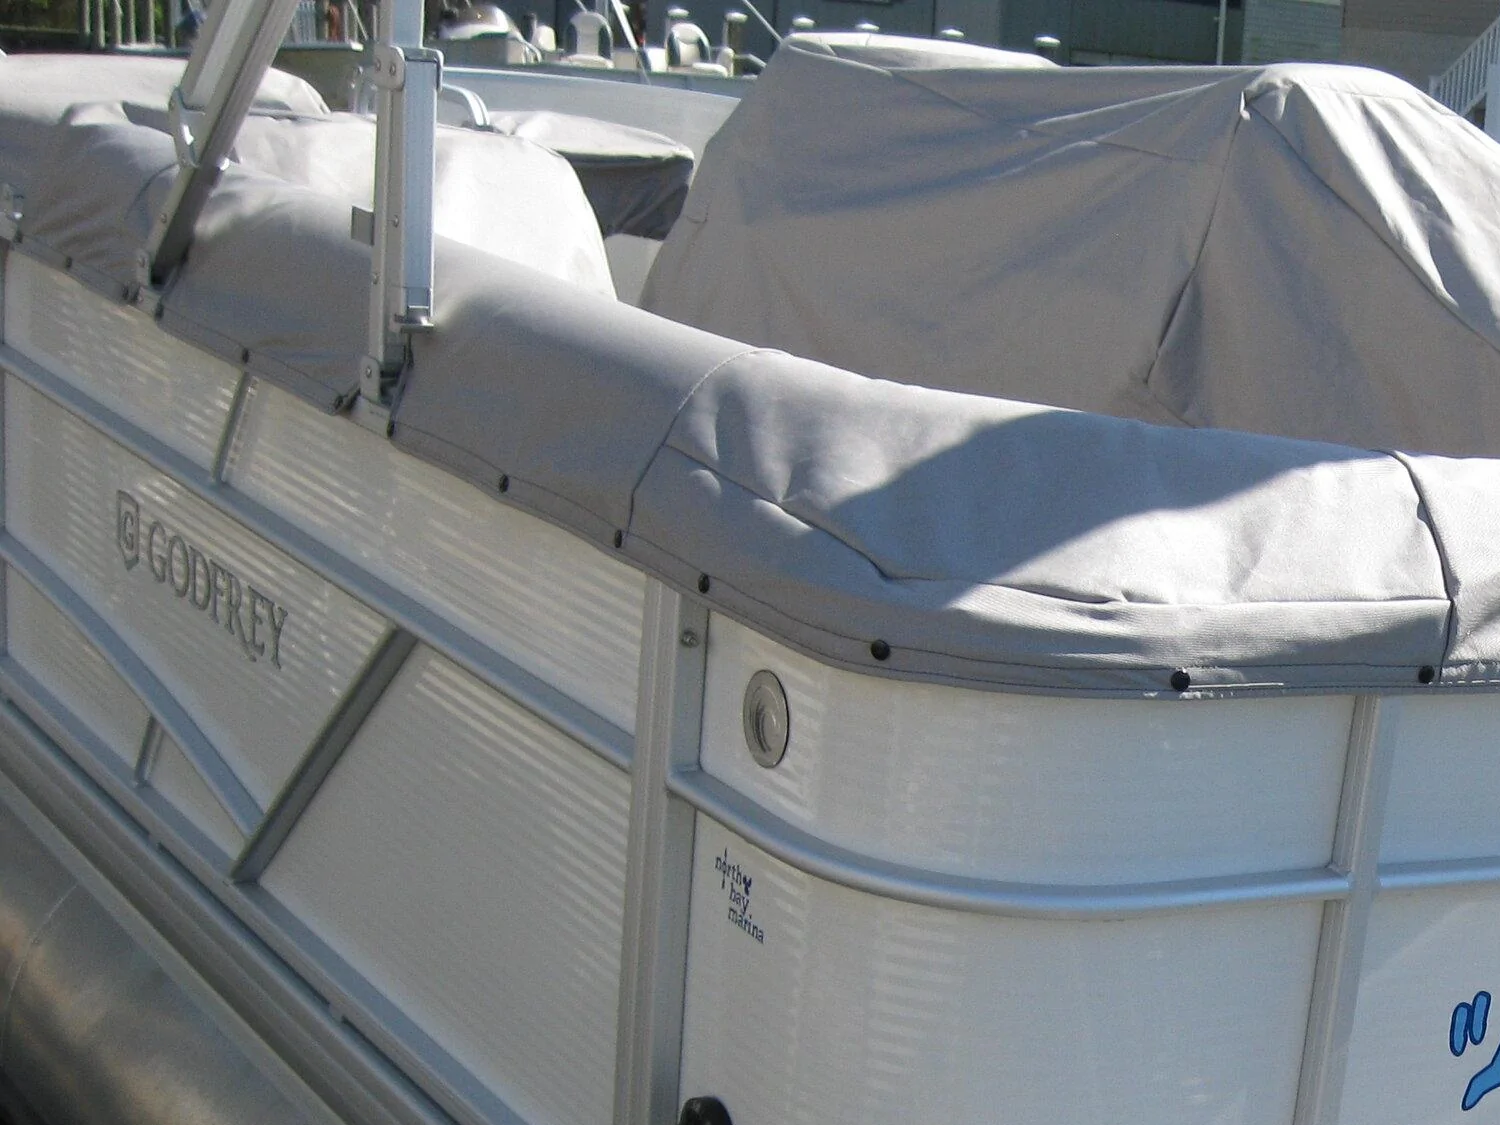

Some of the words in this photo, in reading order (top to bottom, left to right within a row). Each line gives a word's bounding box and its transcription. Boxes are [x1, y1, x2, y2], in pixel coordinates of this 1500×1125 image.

[148, 520, 289, 671] GODFREY
[715, 848, 743, 889] north
[729, 882, 750, 916] bay
[728, 907, 764, 944] marina
